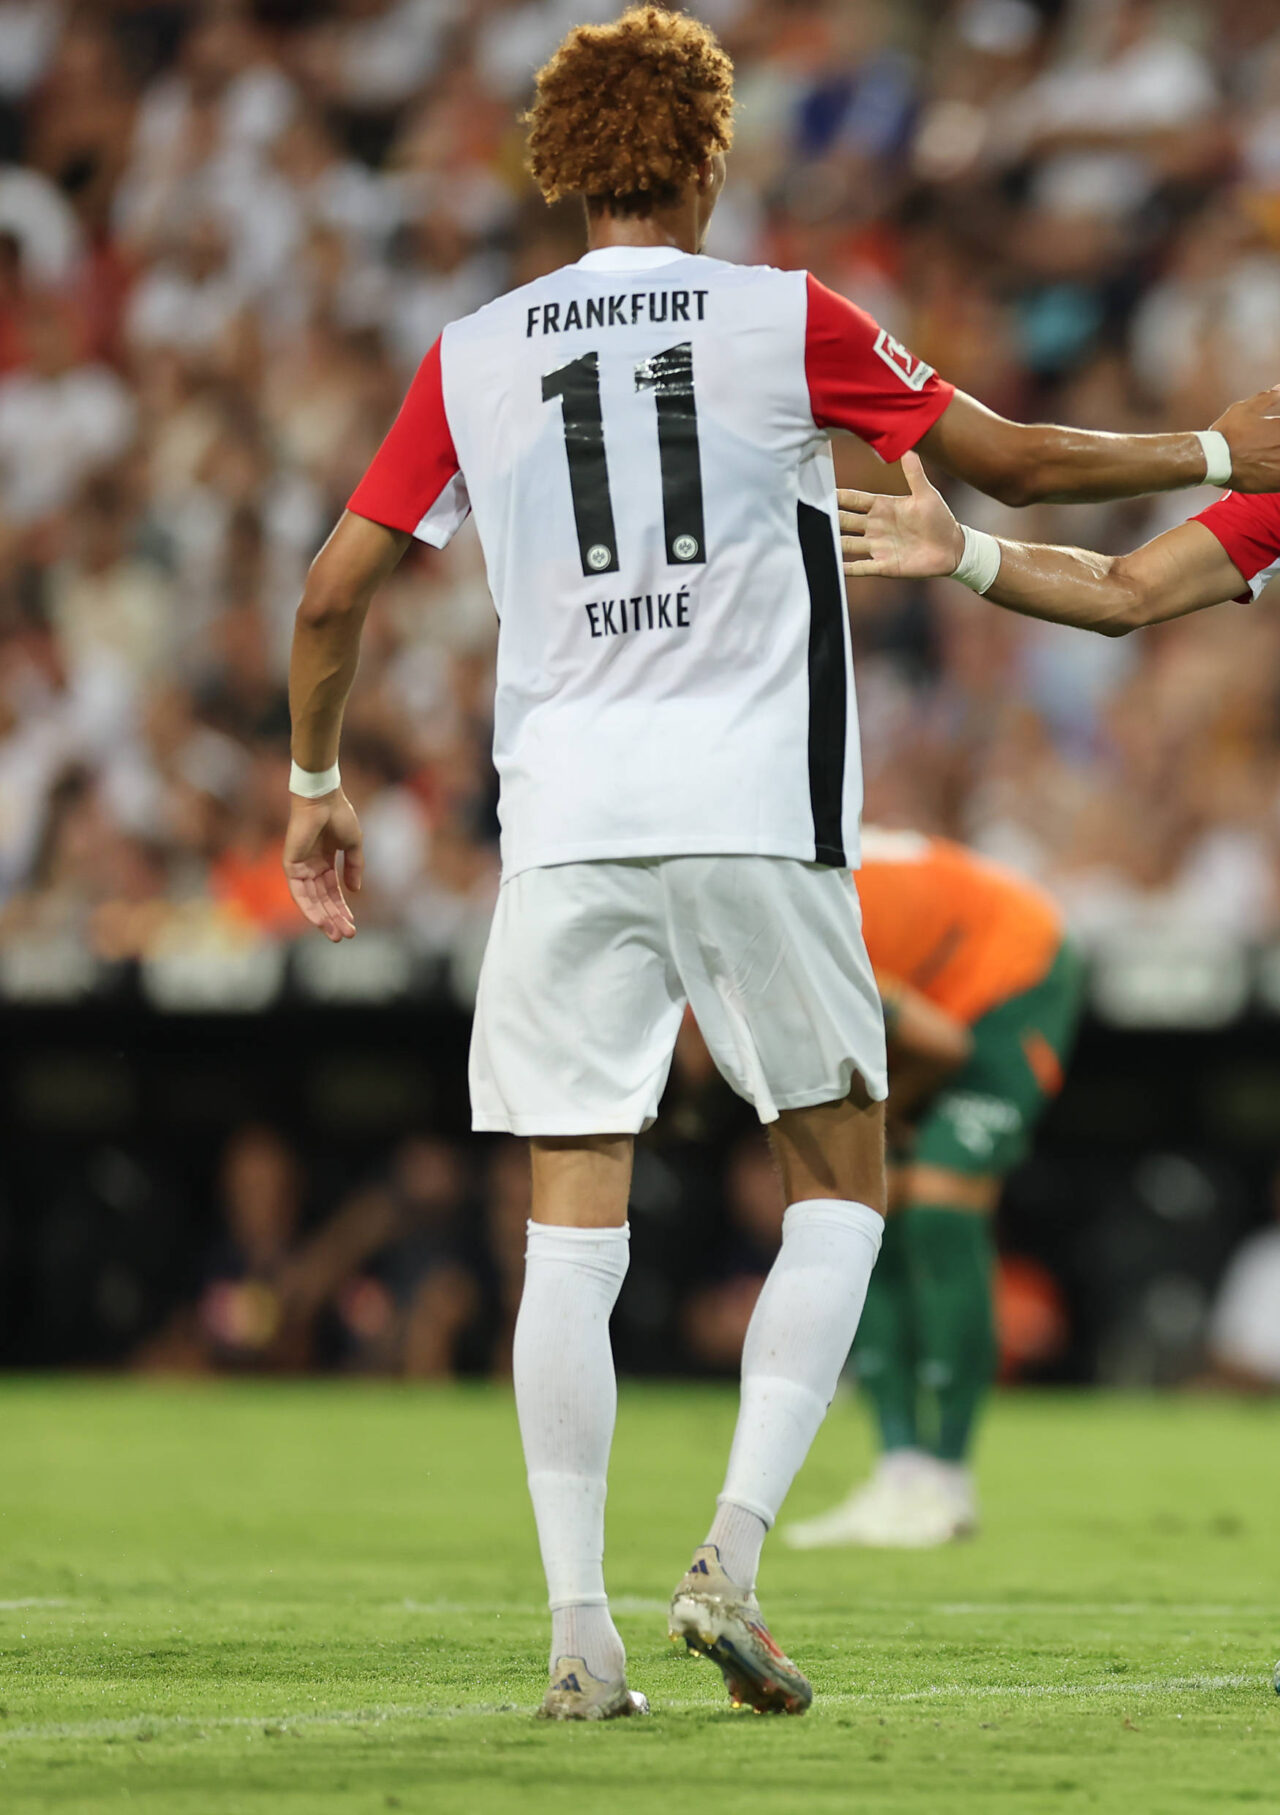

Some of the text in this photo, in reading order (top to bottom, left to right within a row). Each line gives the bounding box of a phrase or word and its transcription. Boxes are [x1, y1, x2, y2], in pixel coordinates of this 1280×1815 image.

[526, 290, 709, 338] FRANKFURT
[541, 341, 707, 577] 11
[585, 583, 691, 638] EKITIKÉ
